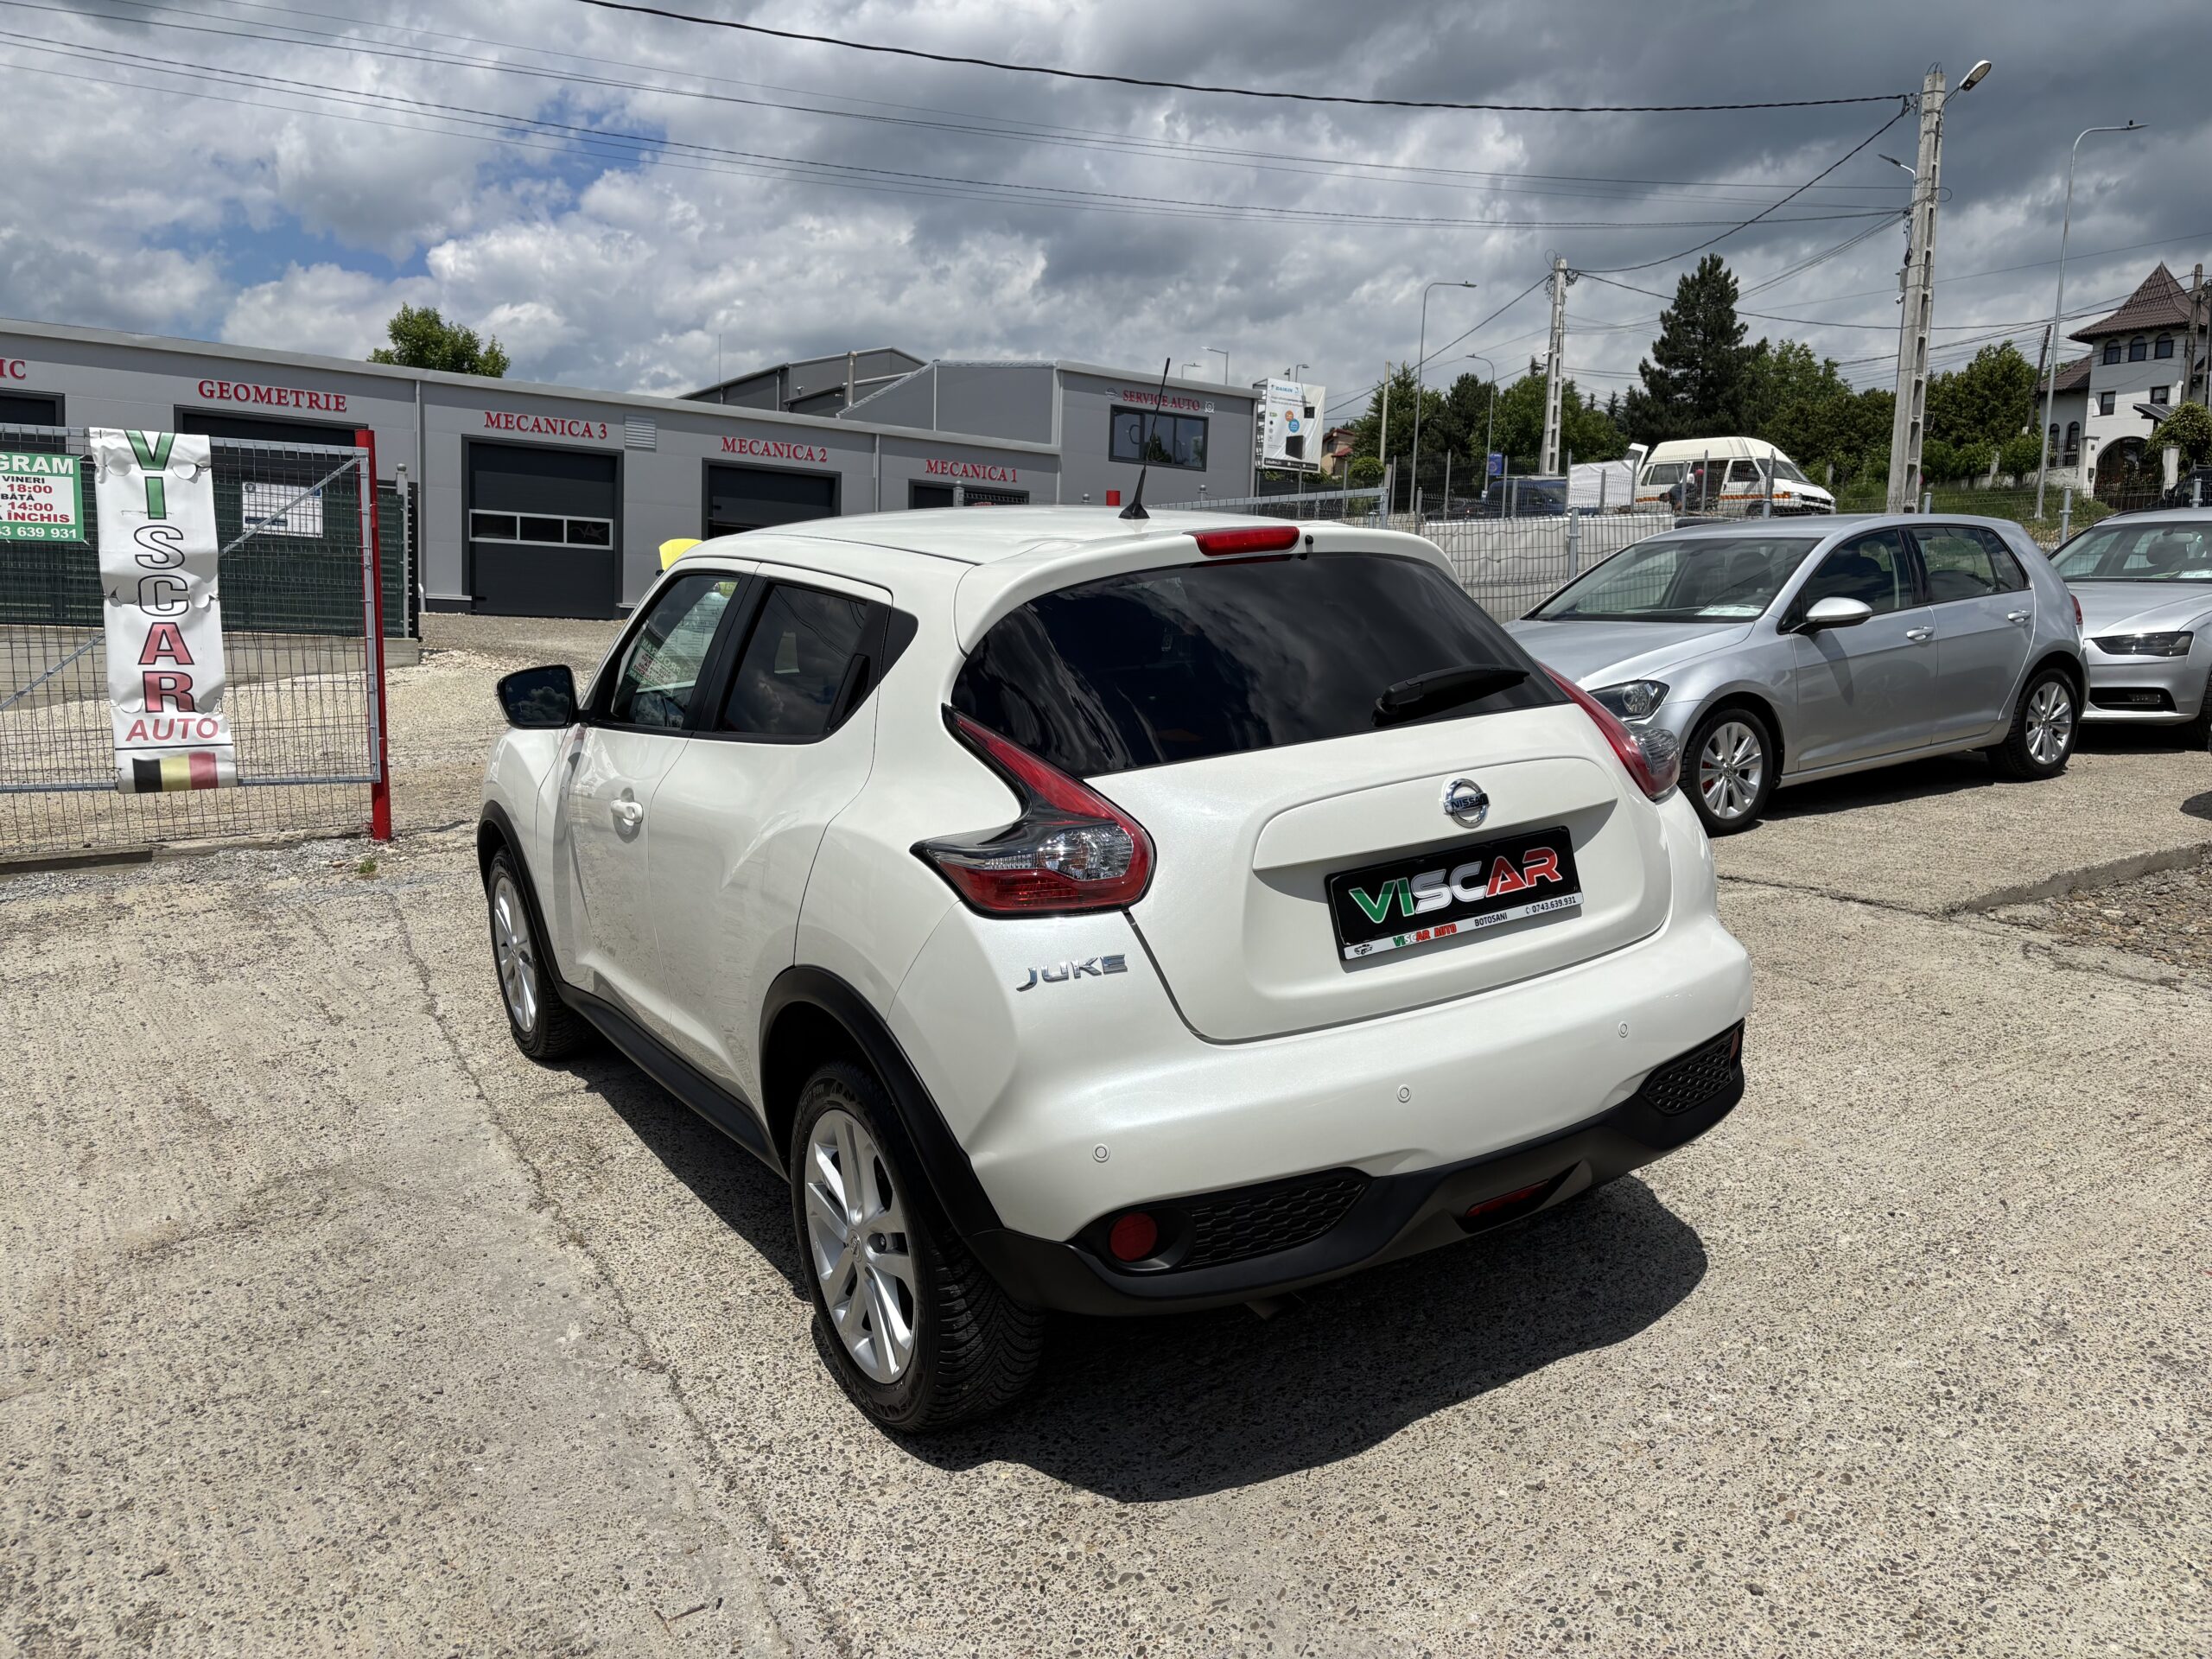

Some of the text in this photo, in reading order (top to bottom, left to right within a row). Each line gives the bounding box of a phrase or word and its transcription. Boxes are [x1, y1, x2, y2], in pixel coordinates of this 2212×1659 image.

[198, 379, 347, 412] GEOMETRIE
[1122, 389, 1200, 411] SERVICE AUTO
[484, 410, 607, 440] MECANICA 3
[721, 436, 828, 462] MECANICA 2
[2, 475, 45, 484] VINERI
[925, 459, 1017, 482] MECANICA 1
[7, 483, 53, 493] 18:00
[7, 510, 70, 523] ÎNCHIS
[8, 501, 54, 512] 14:00
[17, 526, 45, 537] 639
[50, 528, 77, 538] 931
[125, 718, 219, 742] AUTO
[1452, 794, 1486, 808] NISSAN
[1348, 847, 1563, 925] VISCAR
[1393, 896, 1577, 947] VISCAR AUTO BOTOSANI 0743.639.931
[1016, 953, 1128, 993] JUKE
